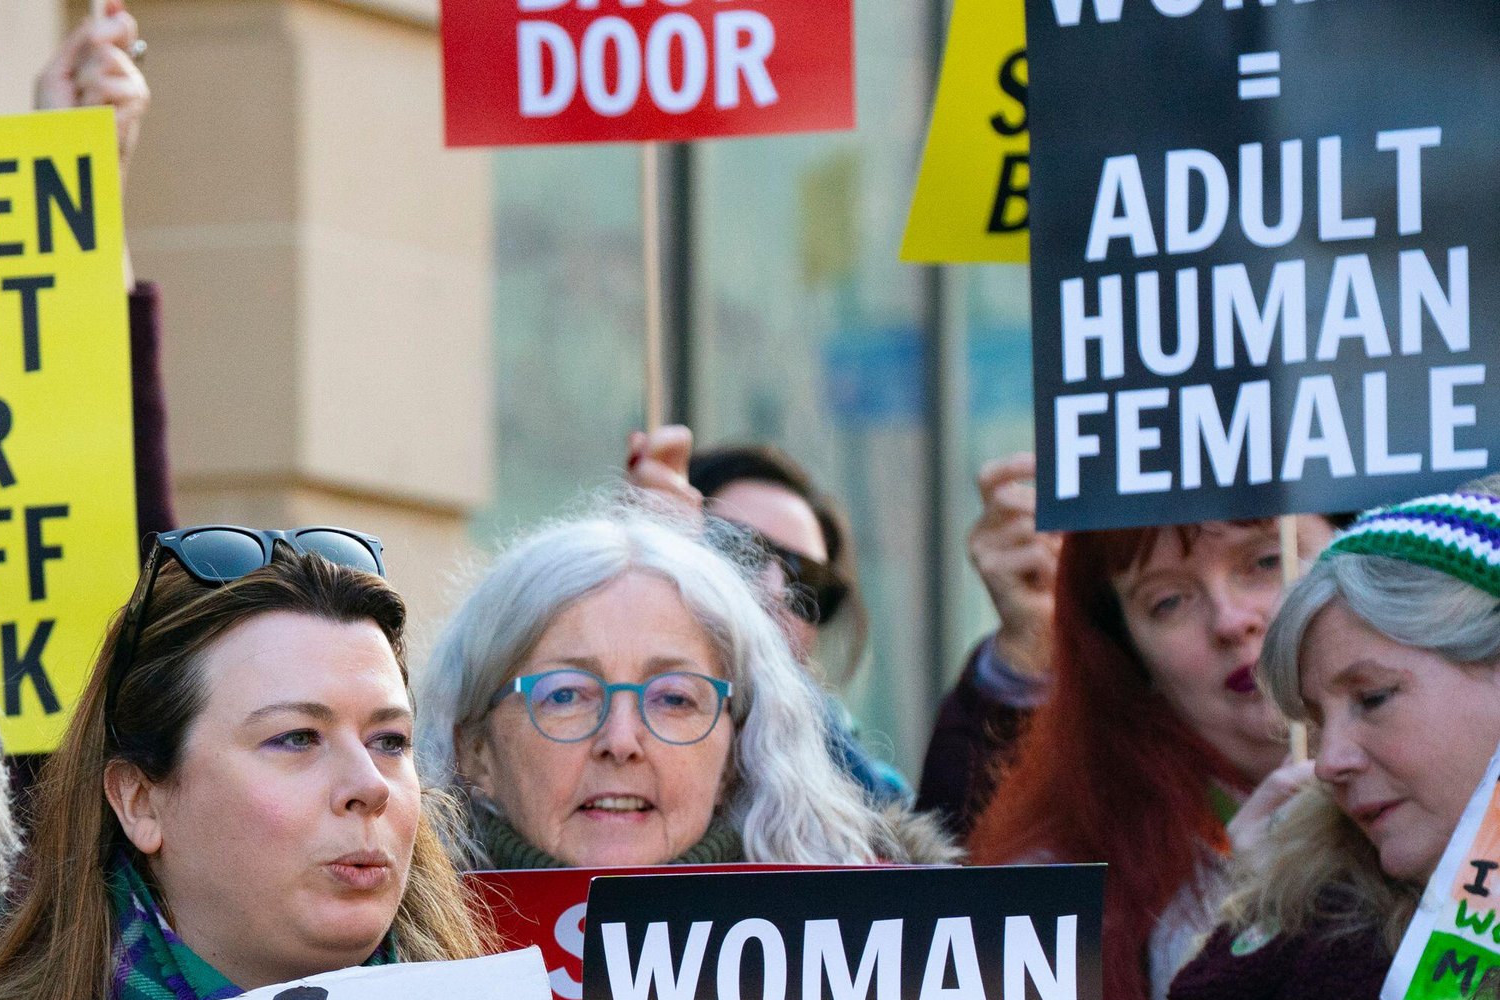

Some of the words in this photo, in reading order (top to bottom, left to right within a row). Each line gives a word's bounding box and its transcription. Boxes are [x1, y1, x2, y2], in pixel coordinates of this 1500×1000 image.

[516, 9, 780, 119] DOOR
[1084, 126, 1443, 262] ADULT
[1059, 246, 1471, 384] HUMAN
[1053, 363, 1490, 501] FEMALE
